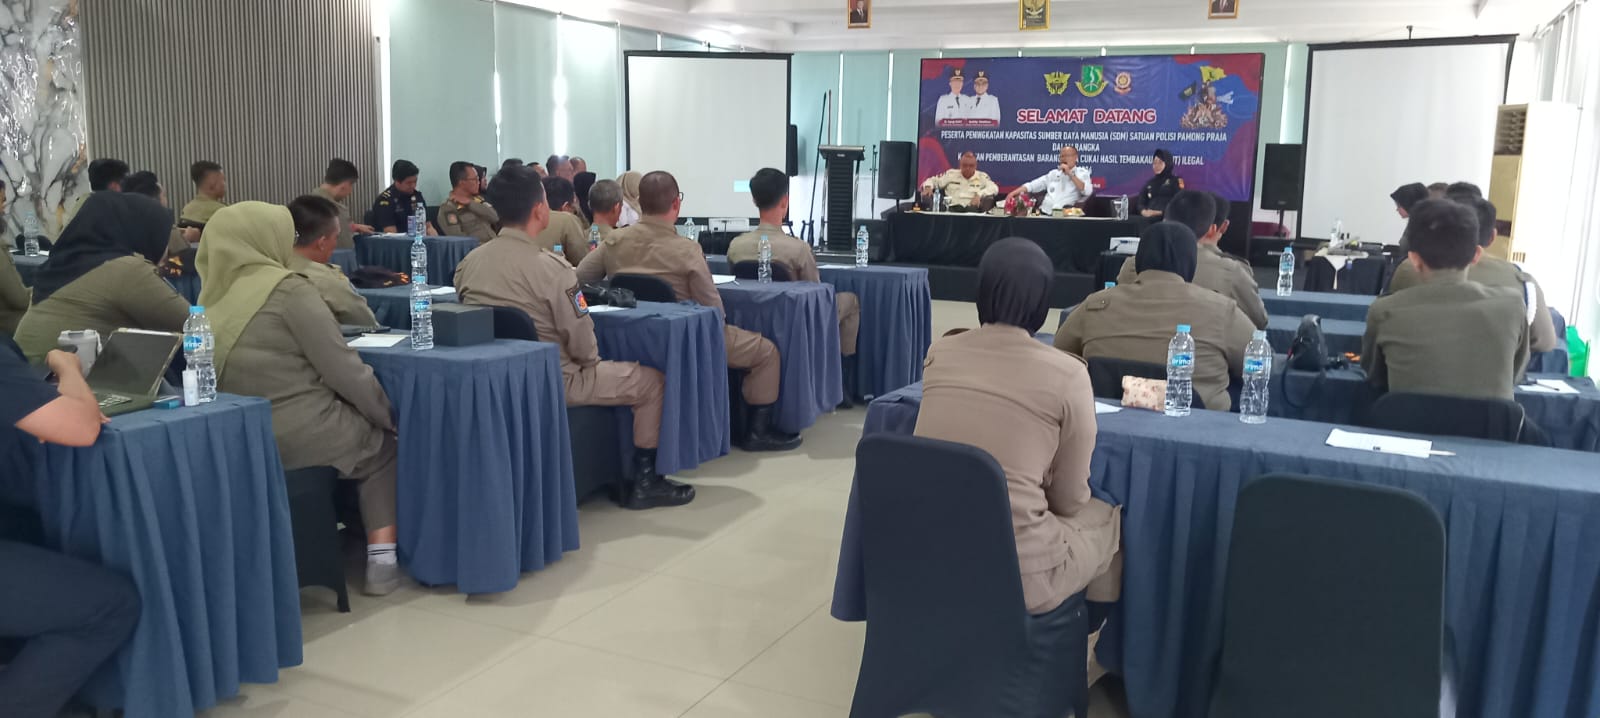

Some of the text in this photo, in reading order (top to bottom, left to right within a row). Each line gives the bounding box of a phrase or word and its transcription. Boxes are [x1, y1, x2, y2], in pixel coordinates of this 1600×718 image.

[1017, 108, 1157, 124] SELAMAT DATANG
[941, 130, 965, 140] PESERTA
[965, 130, 1005, 140] PENINGKATAN
[1005, 131, 1037, 140] KAPASITAS
[1038, 131, 1062, 141] SUMBER
[1063, 131, 1080, 141] DAYA
[1080, 132, 1109, 141] MANUSIA
[1129, 132, 1155, 141] SATUAN
[1155, 132, 1177, 141] POLISI
[1177, 132, 1206, 142] PAMONG
[1206, 132, 1228, 142] PRAJA
[985, 152, 1035, 163] PEMBERANTASAN
[1080, 154, 1100, 164] CUKAI
[1100, 154, 1119, 164] HASIL
[1119, 154, 1154, 165] TEMBAKAU
[1181, 155, 1205, 166] ILEGAL
